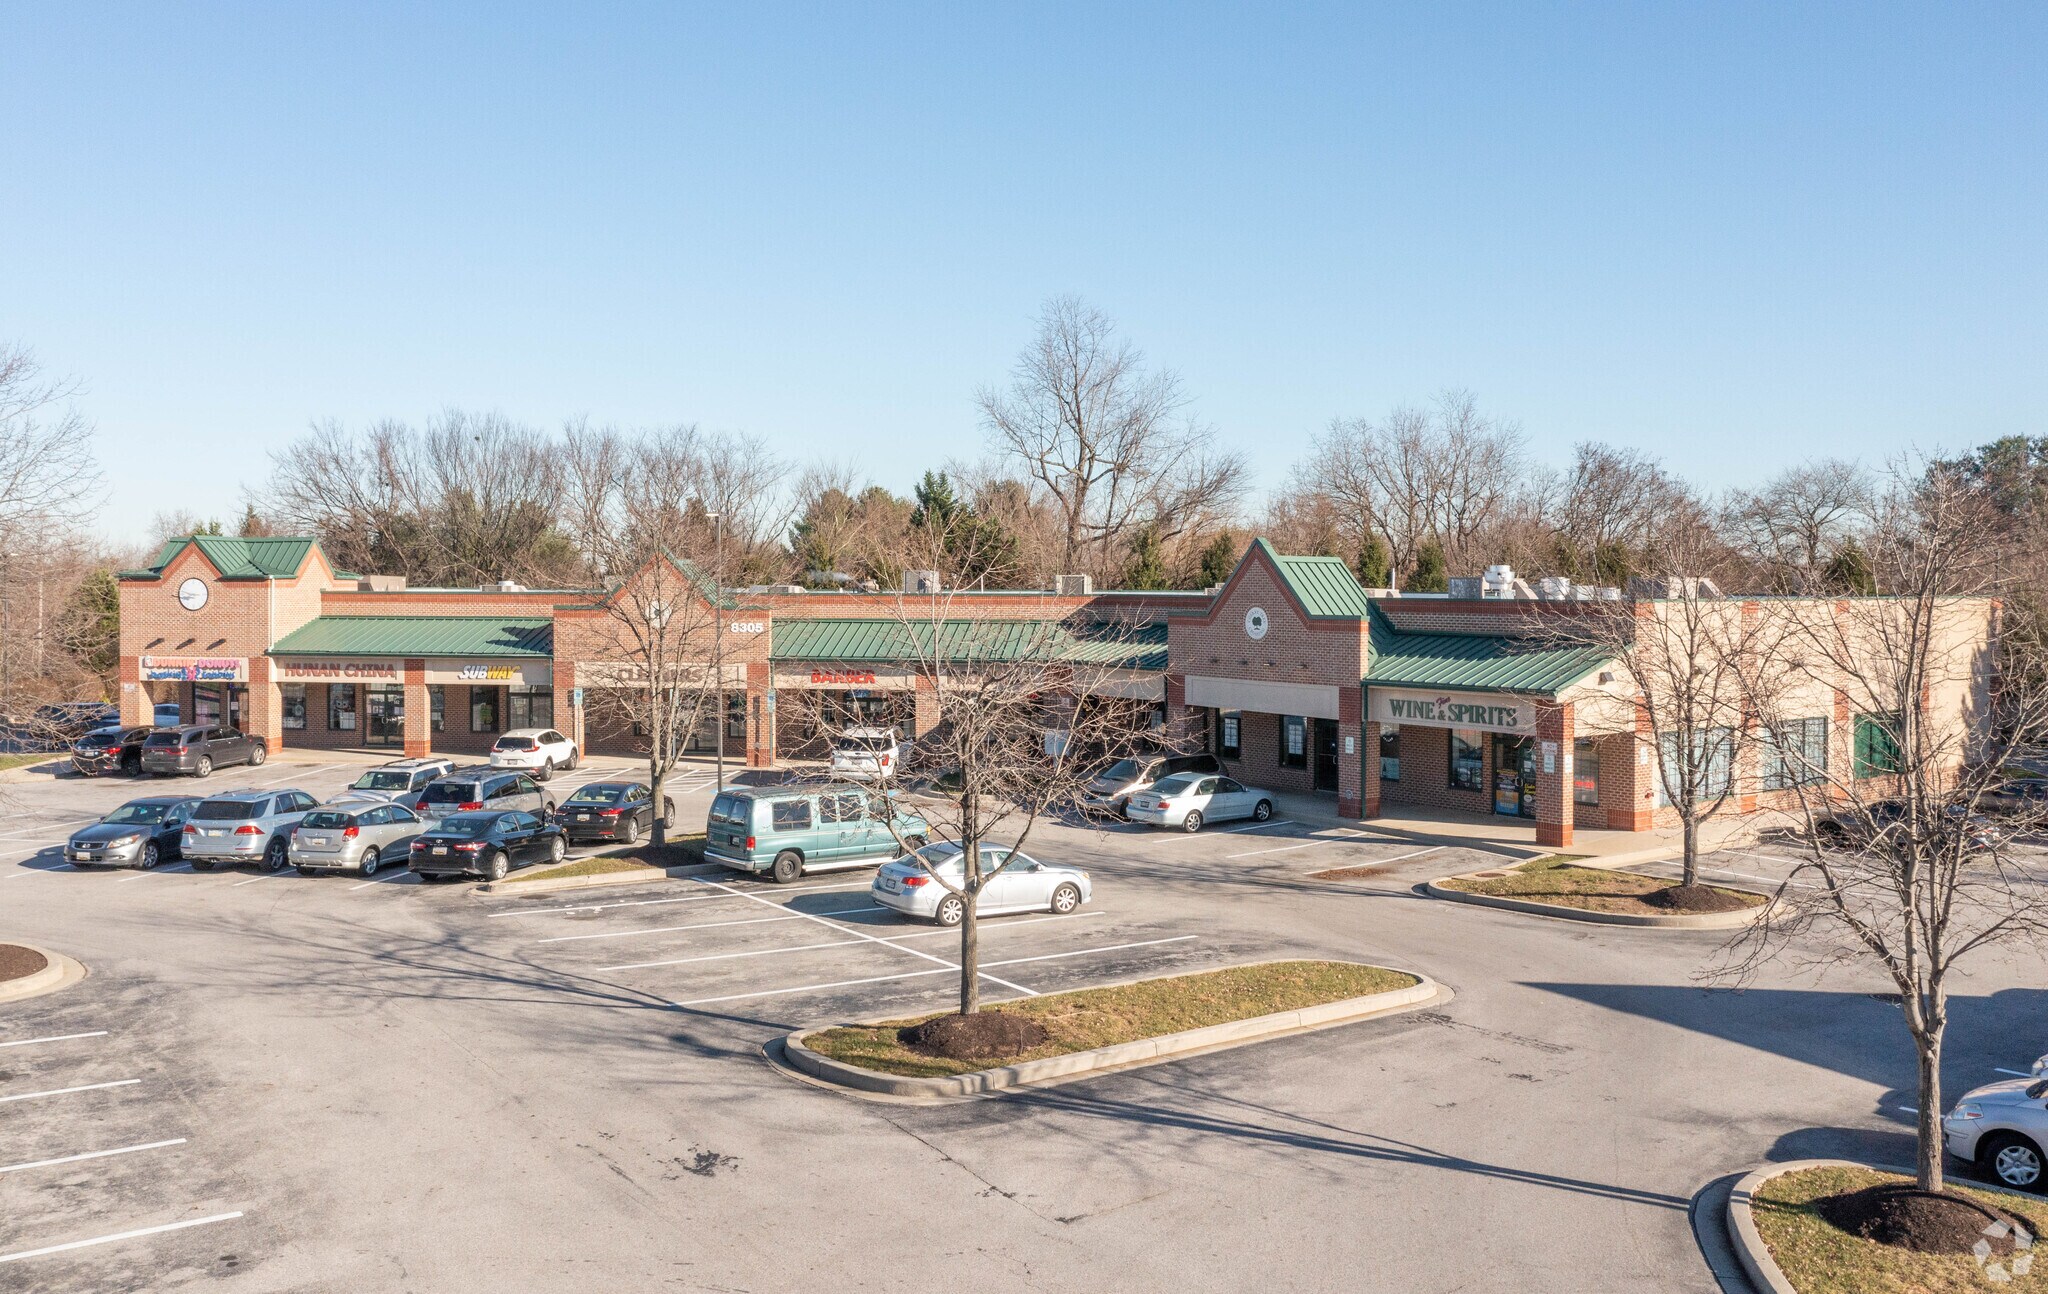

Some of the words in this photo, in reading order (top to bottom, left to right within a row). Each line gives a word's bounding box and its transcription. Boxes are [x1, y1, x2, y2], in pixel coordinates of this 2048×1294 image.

[730, 622, 763, 633] 8305
[198, 659, 240, 669] DONUTS
[284, 662, 340, 677] HUNAN
[344, 663, 396, 678] CHINA
[459, 664, 521, 680] SUBWAY
[617, 668, 703, 682] CLENERS
[811, 669, 876, 684] BARBER
[1389, 698, 1435, 720] WINE
[1437, 709, 1446, 721] &
[1447, 703, 1518, 727] SPIRITS
